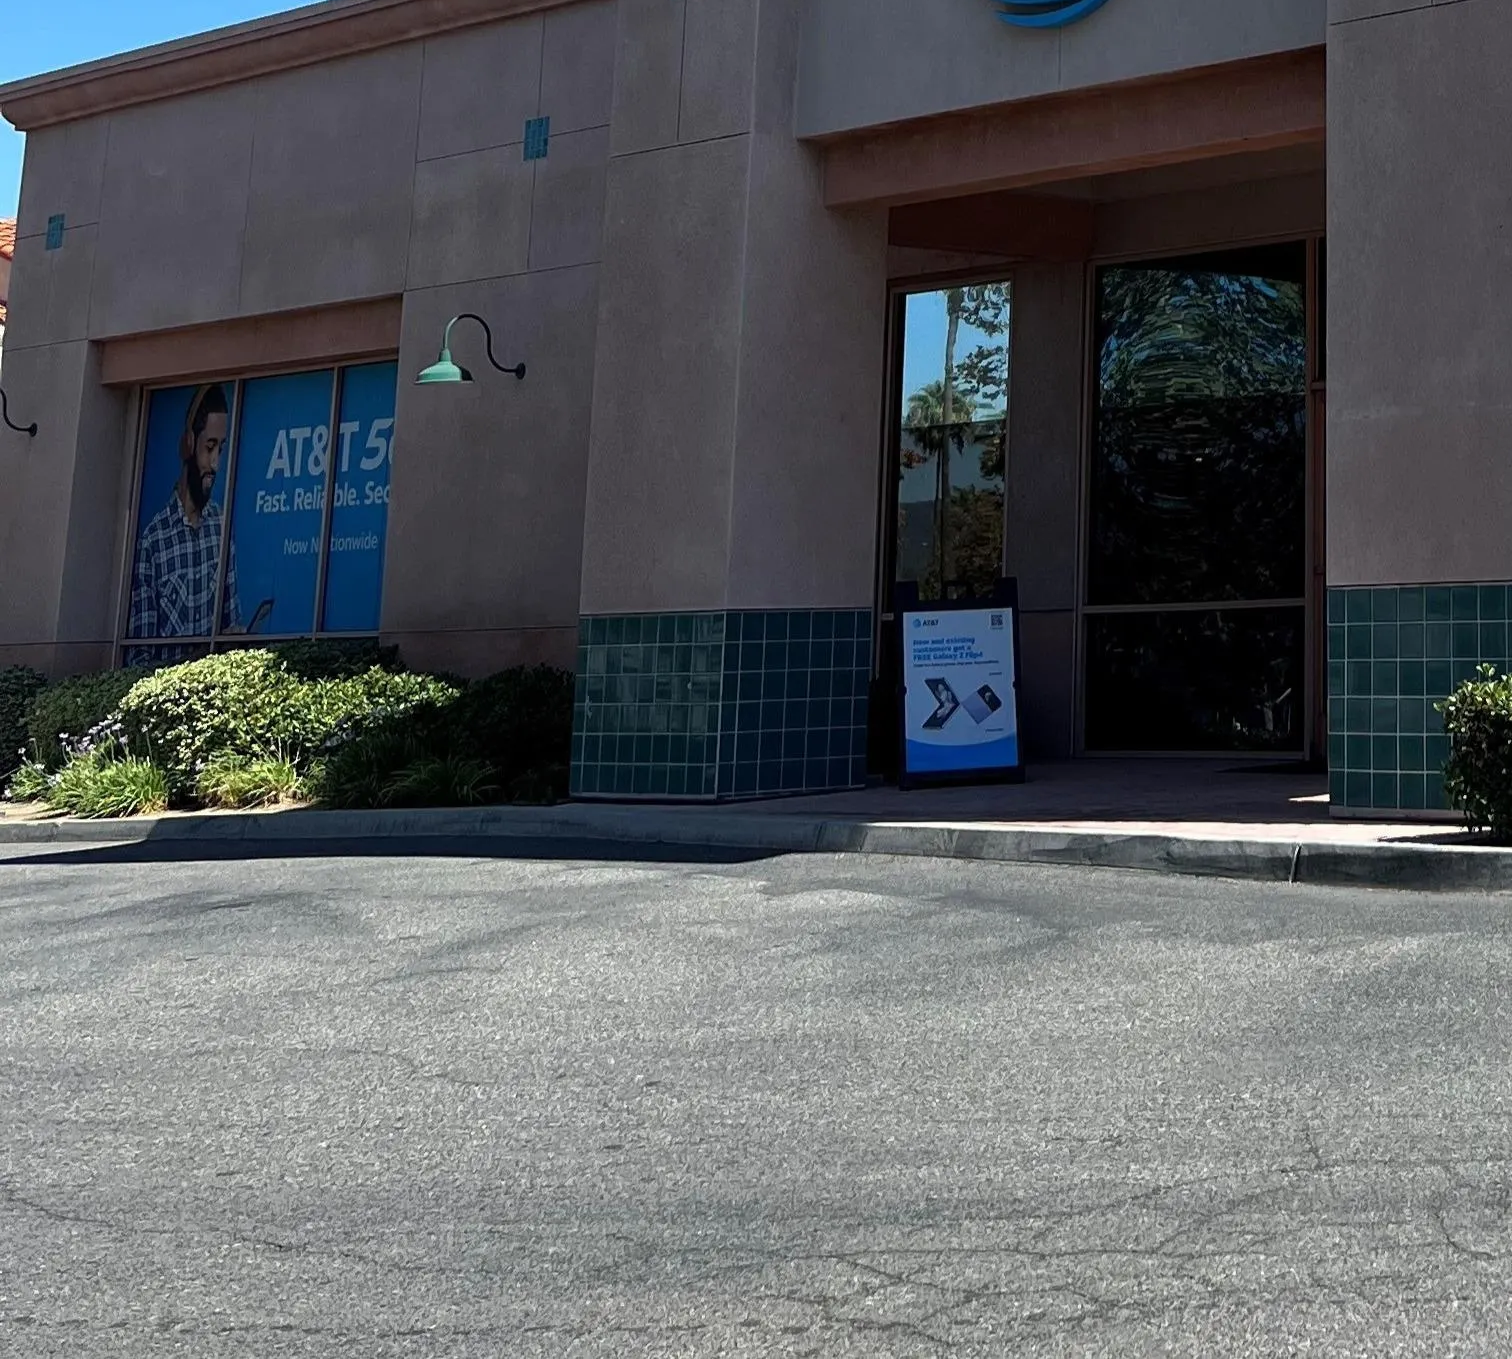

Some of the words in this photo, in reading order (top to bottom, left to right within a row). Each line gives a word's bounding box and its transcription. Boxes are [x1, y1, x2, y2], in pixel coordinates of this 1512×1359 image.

[265, 420, 360, 479] AT&T
[255, 490, 290, 513] Fast.
[283, 538, 309, 555] Now
[310, 530, 379, 553] Ntionwide
